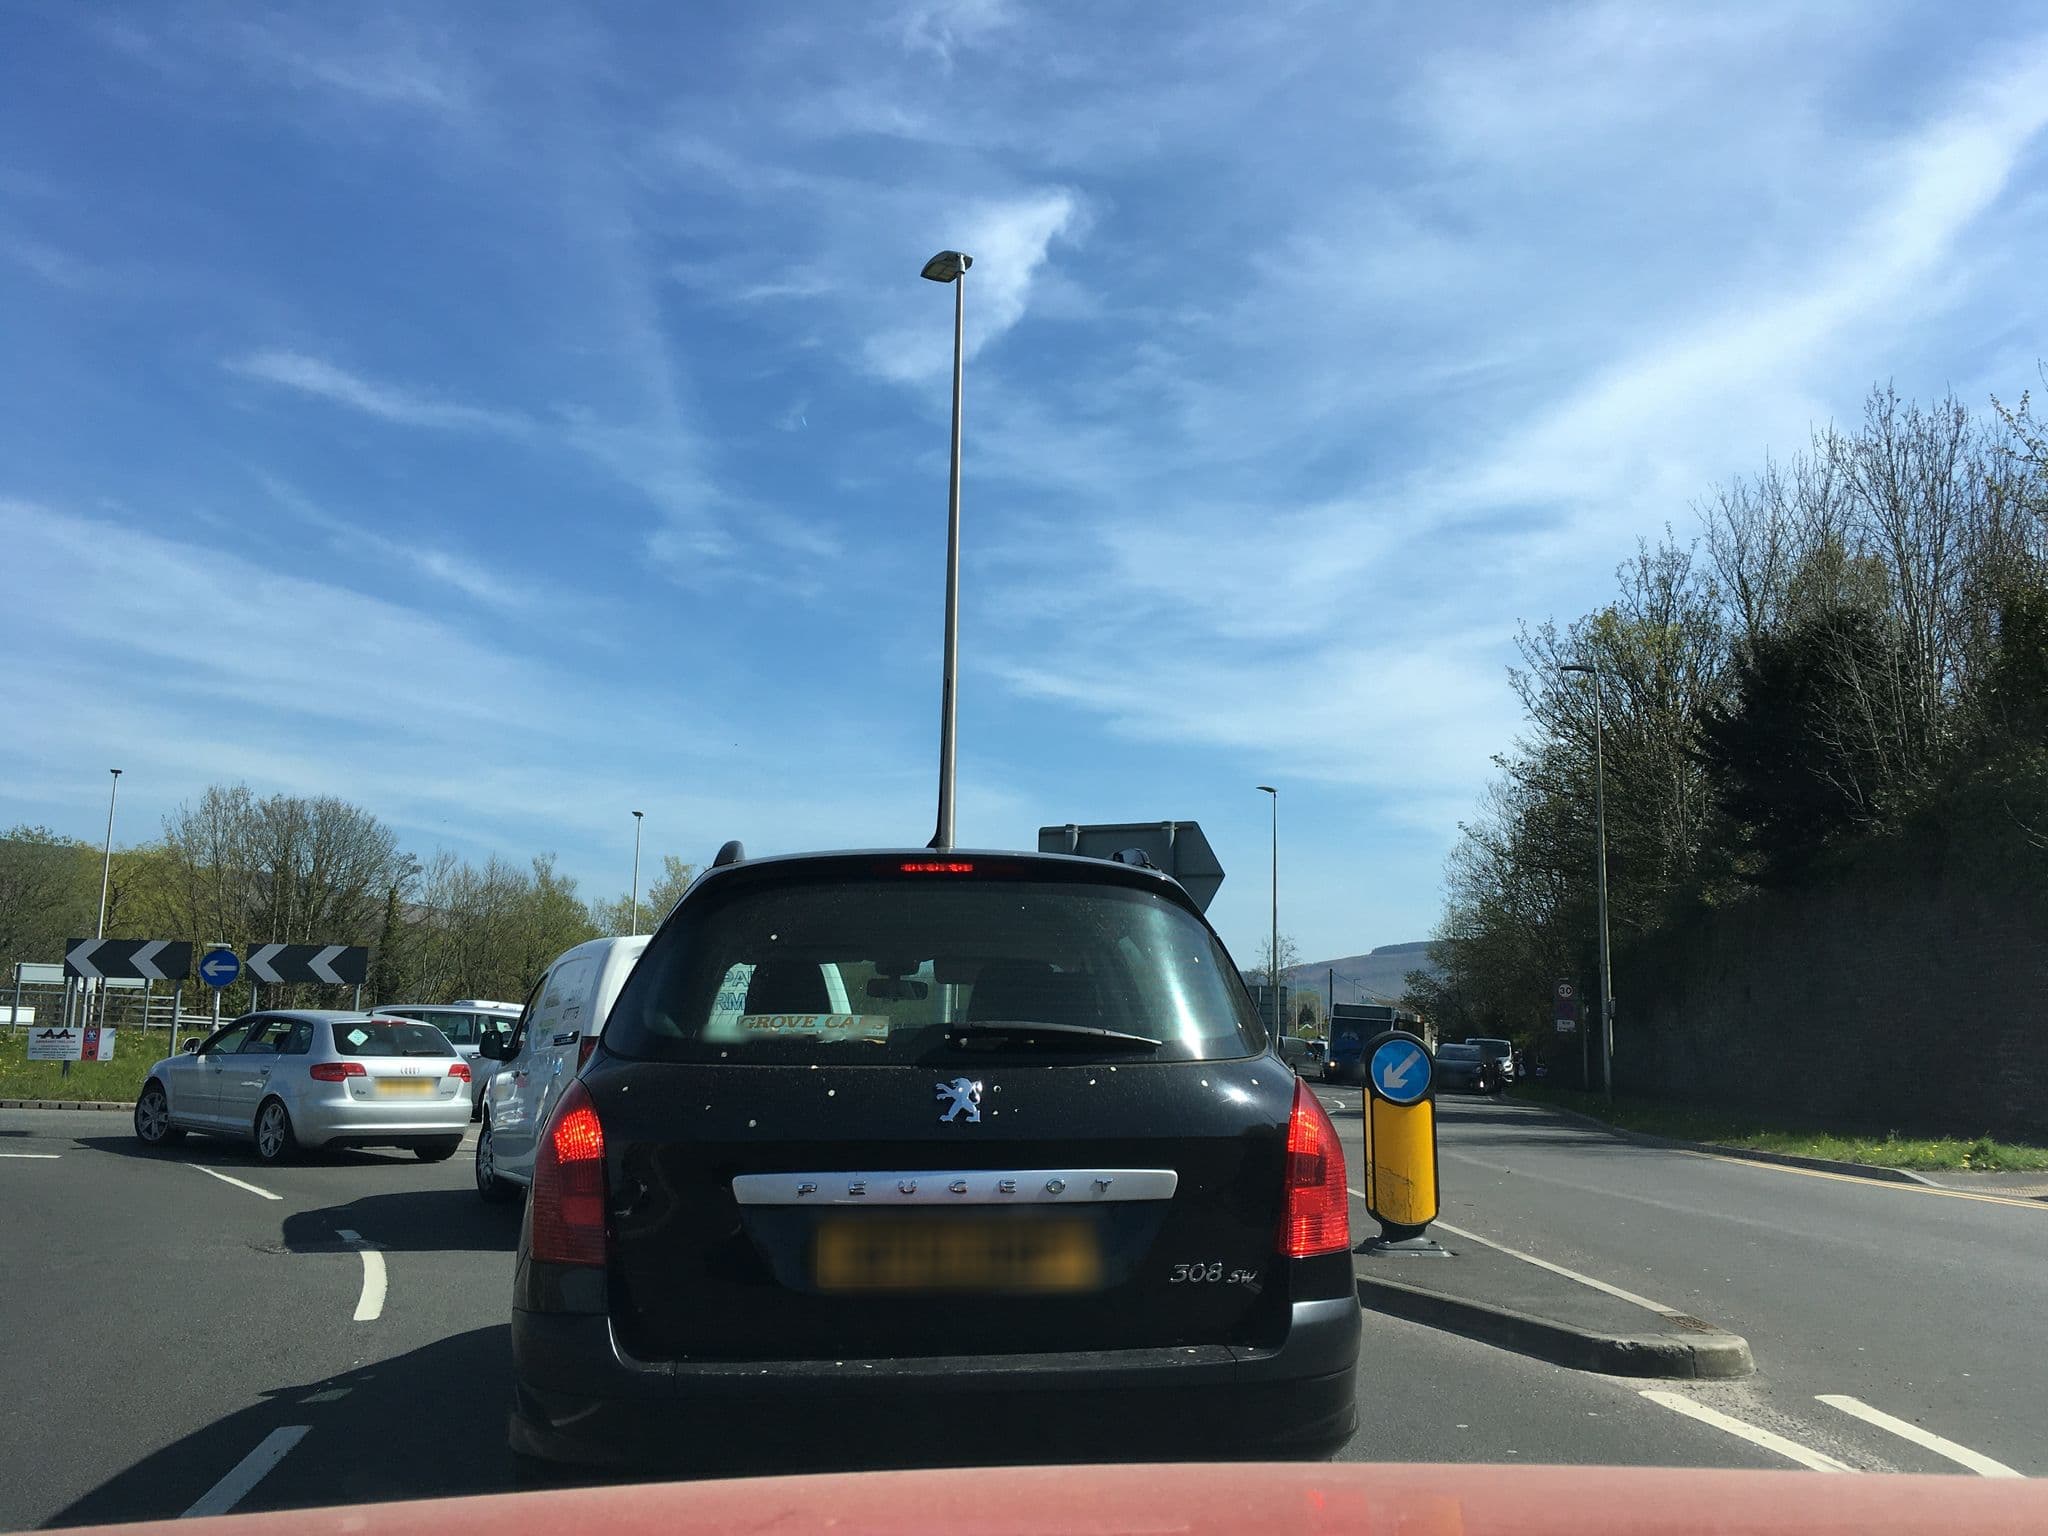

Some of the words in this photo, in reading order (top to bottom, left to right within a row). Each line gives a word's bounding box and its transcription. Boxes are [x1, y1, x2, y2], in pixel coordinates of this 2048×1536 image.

[1559, 986, 1572, 995] 30
[740, 1015, 818, 1029] GROVE
[797, 1177, 1114, 1198] PEUGEOT
[1169, 1262, 1223, 1283] 308
[1226, 1269, 1259, 1284] SW
